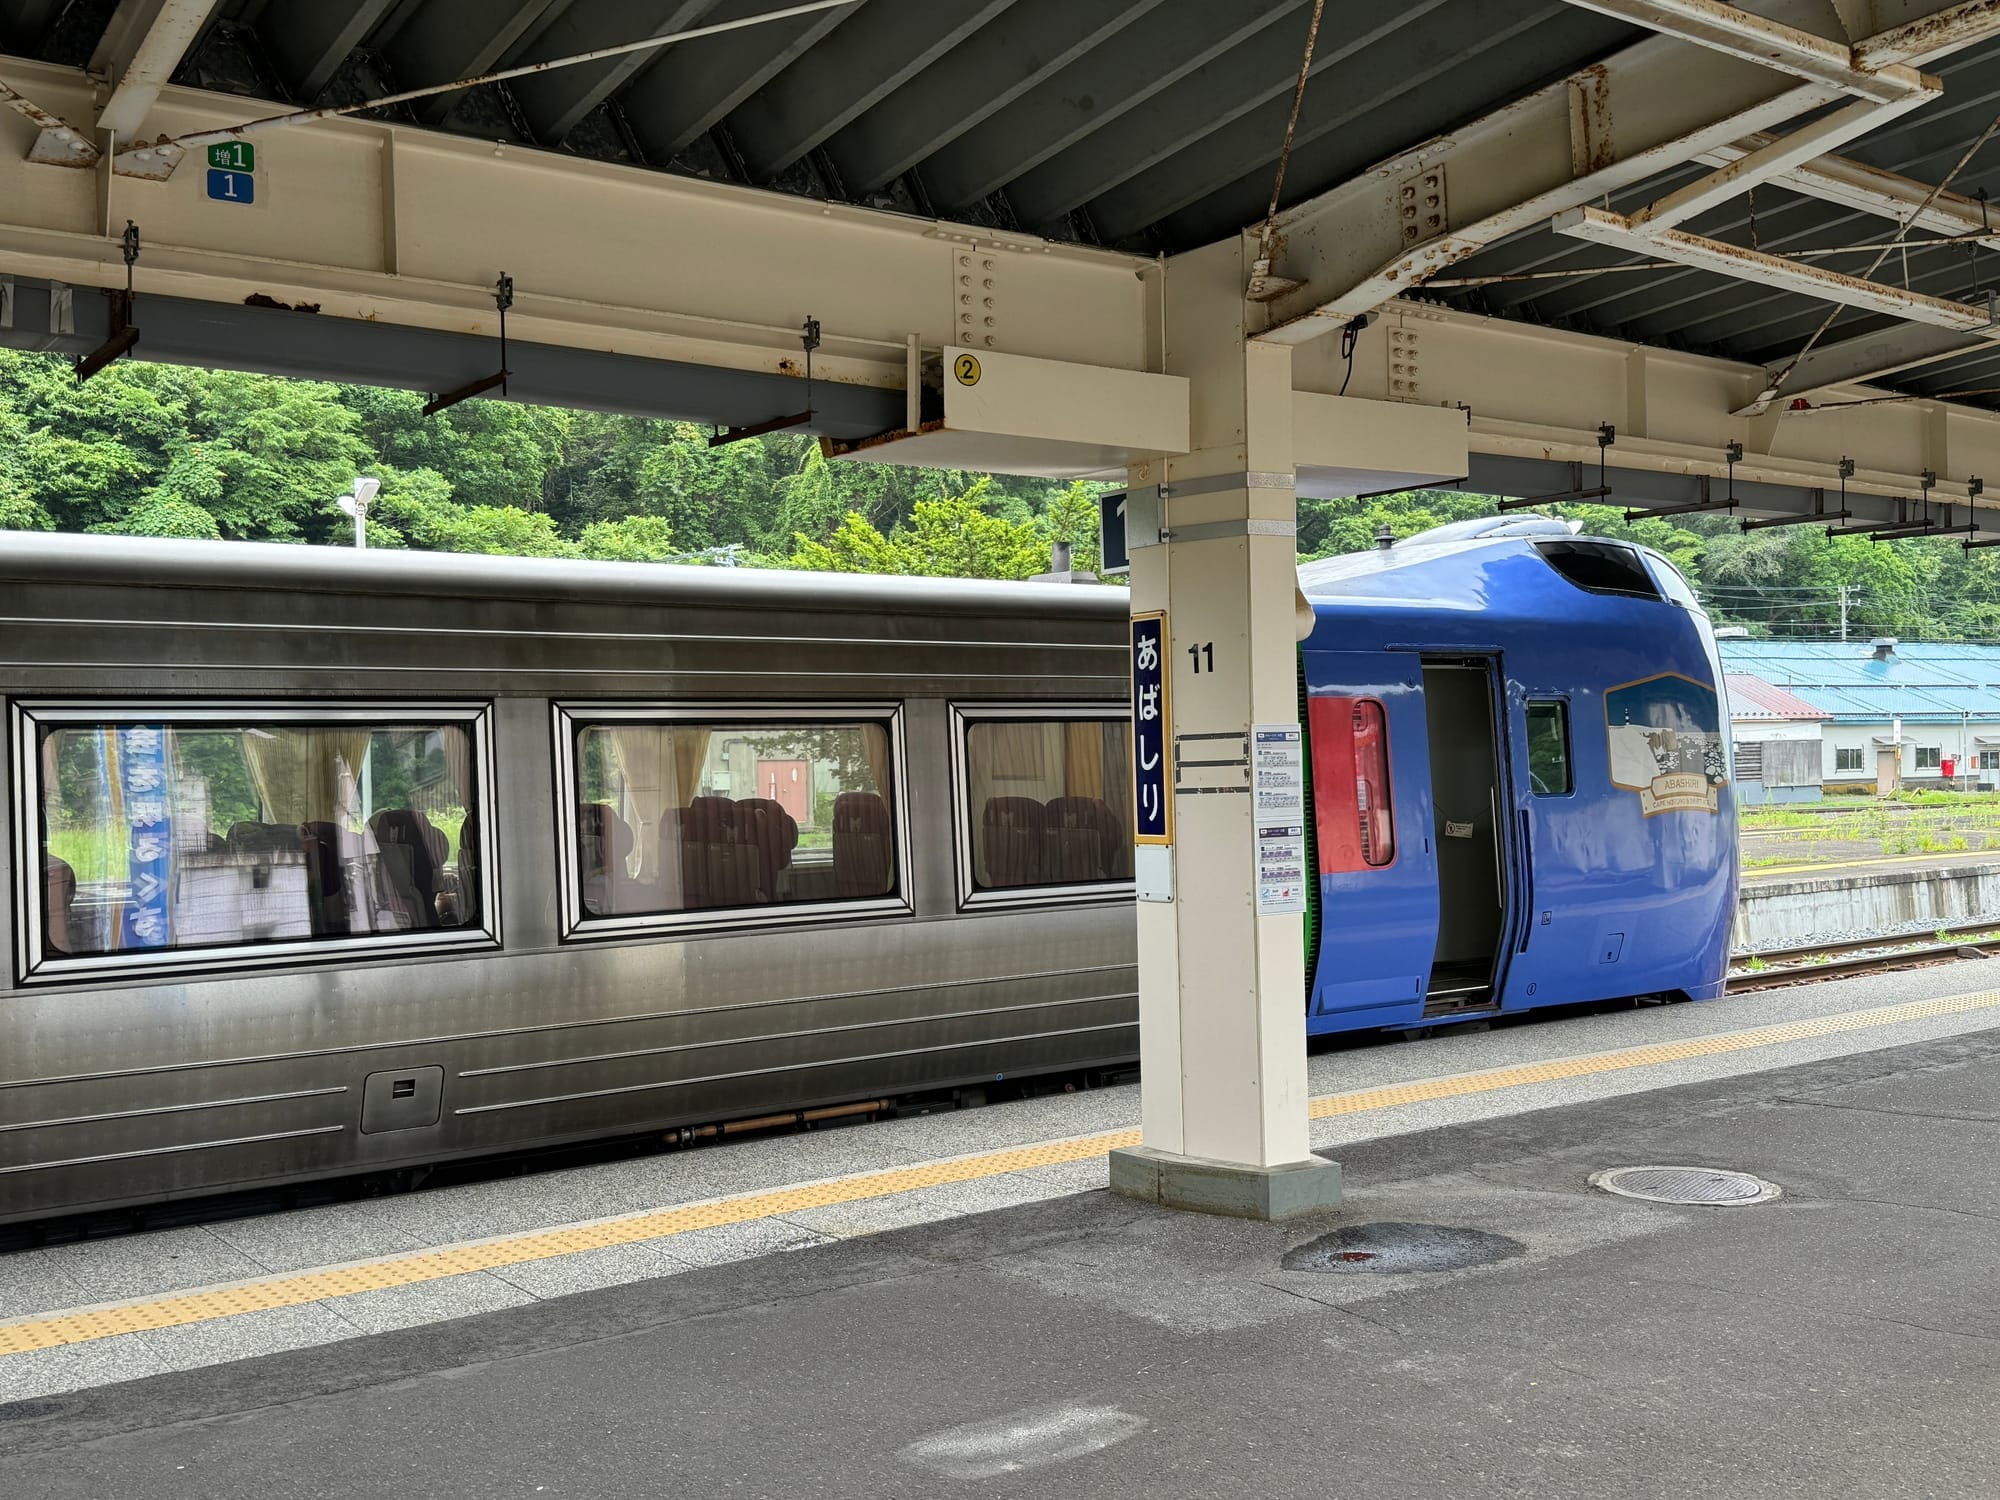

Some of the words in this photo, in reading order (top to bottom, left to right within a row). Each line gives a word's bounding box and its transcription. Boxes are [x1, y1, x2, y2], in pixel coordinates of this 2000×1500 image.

[224, 174, 238, 198] 1
[1188, 641, 1214, 674] 11
[1137, 635, 1161, 822] あばしり
